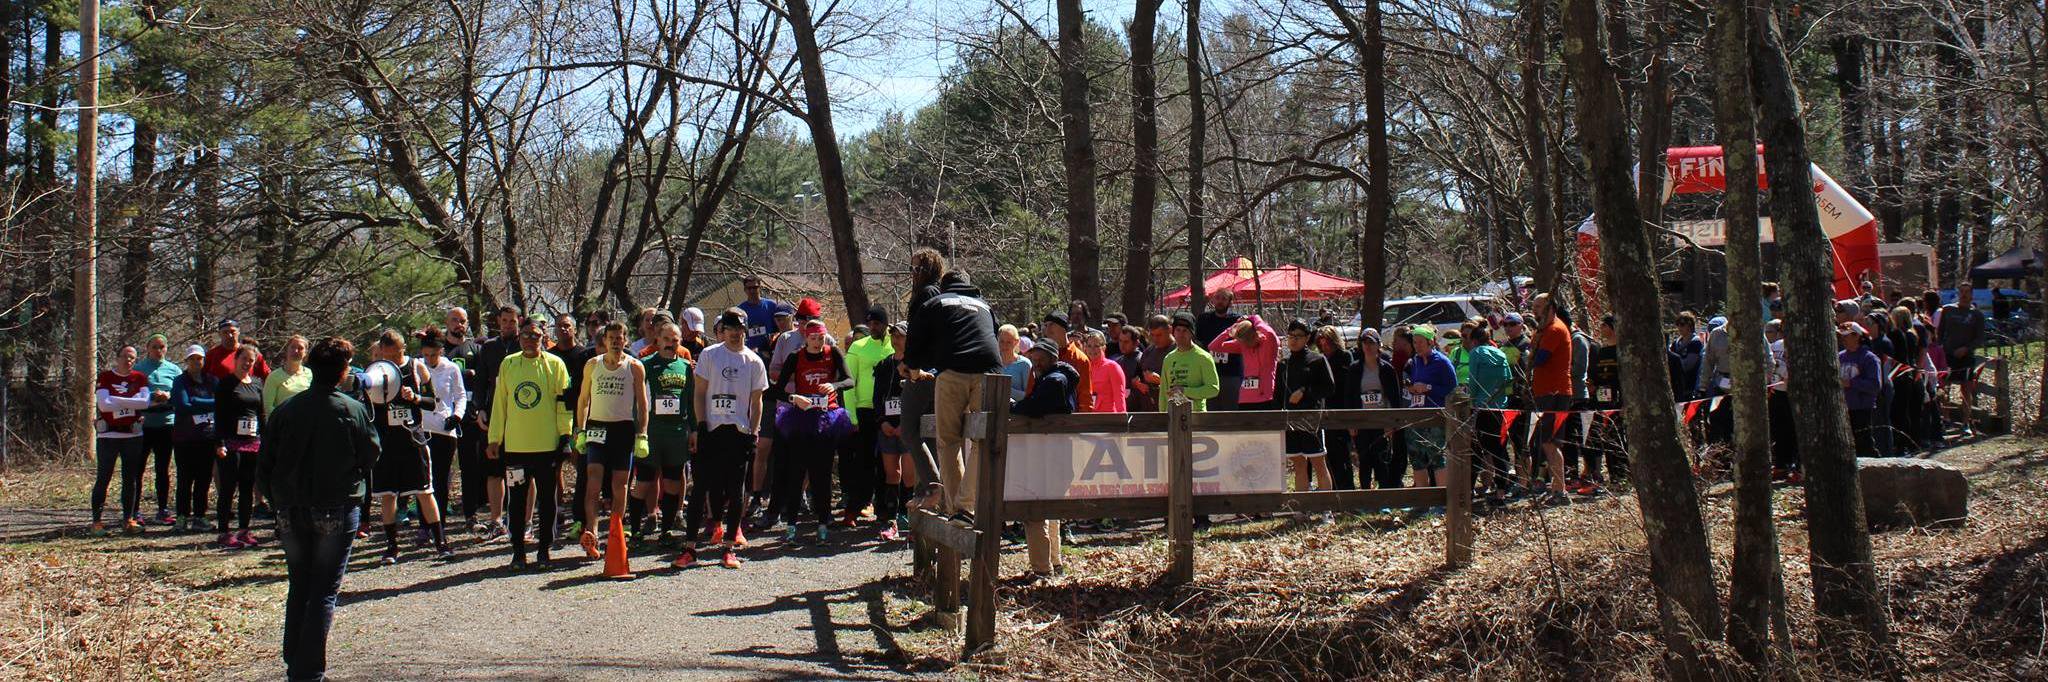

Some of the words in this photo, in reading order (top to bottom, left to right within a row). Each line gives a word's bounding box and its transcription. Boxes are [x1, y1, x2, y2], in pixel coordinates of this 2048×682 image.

[662, 400, 674, 408] 46
[715, 400, 732, 408] 112
[393, 409, 408, 419] 155
